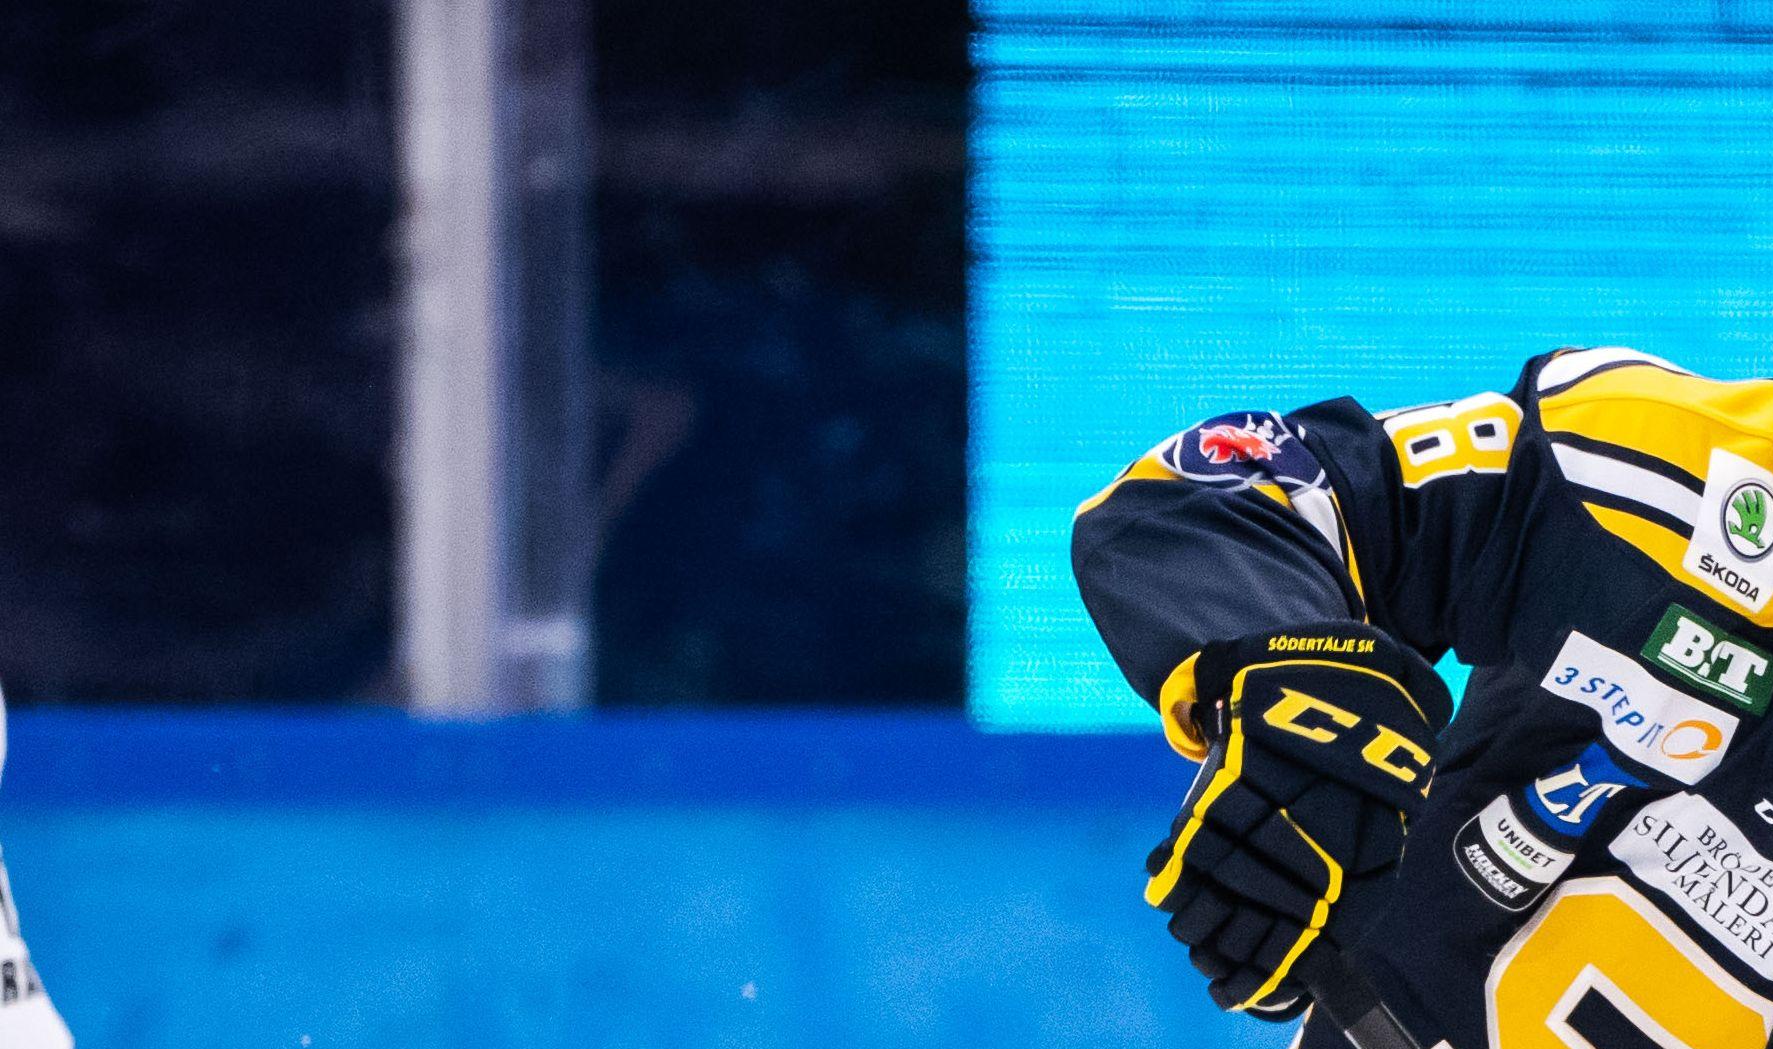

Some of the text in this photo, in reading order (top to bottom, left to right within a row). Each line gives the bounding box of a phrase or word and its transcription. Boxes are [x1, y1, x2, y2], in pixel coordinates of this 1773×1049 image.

[1376, 391, 1523, 489] 8
[1698, 554, 1760, 603] ŠKODA
[1267, 635, 1375, 652] SÖDERTÄLJE SK
[1554, 666, 1580, 685] 3
[1580, 677, 1645, 727] STEP
[1263, 687, 1437, 798] CC
[1497, 818, 1555, 868] UNIBET
